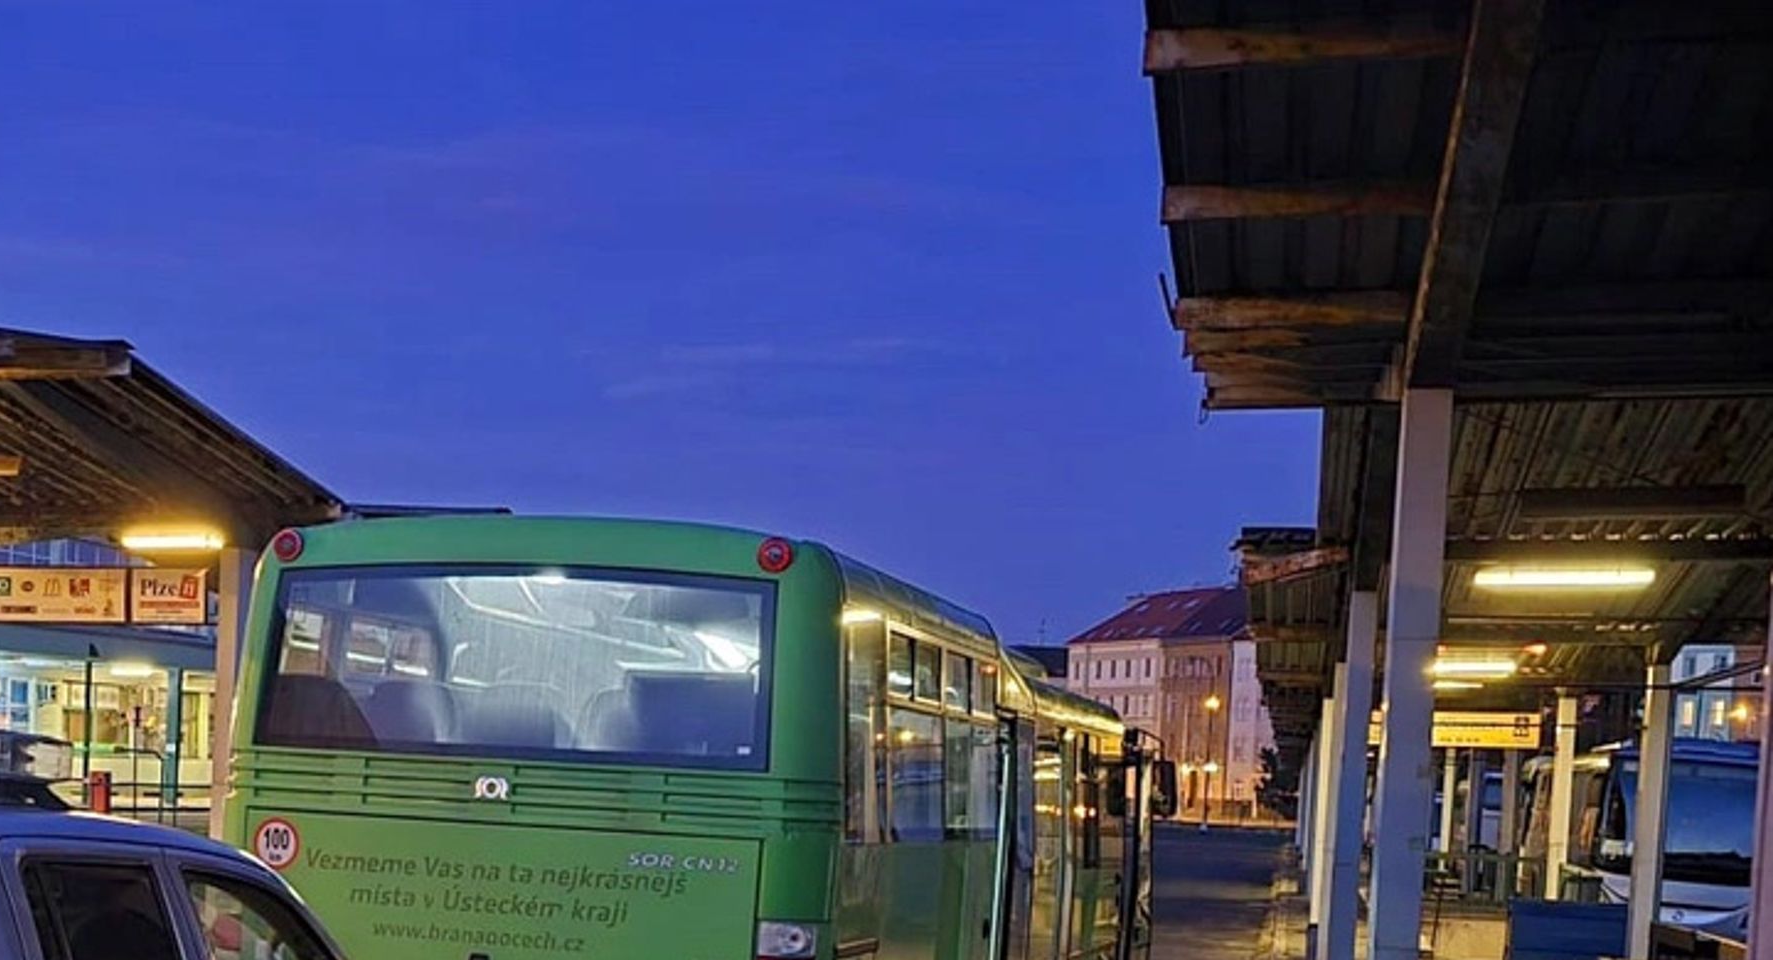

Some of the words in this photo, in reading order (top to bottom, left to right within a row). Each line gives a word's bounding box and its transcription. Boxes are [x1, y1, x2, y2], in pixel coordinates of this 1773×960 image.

[264, 828, 290, 850] 100
[306, 848, 416, 876] Vezmeme
[424, 856, 464, 880] Vas
[470, 864, 500, 881] na
[509, 863, 533, 880] ta
[628, 853, 675, 869] SOR
[349, 884, 416, 908] místa
[422, 894, 436, 908] v
[571, 898, 627, 928] kraji
